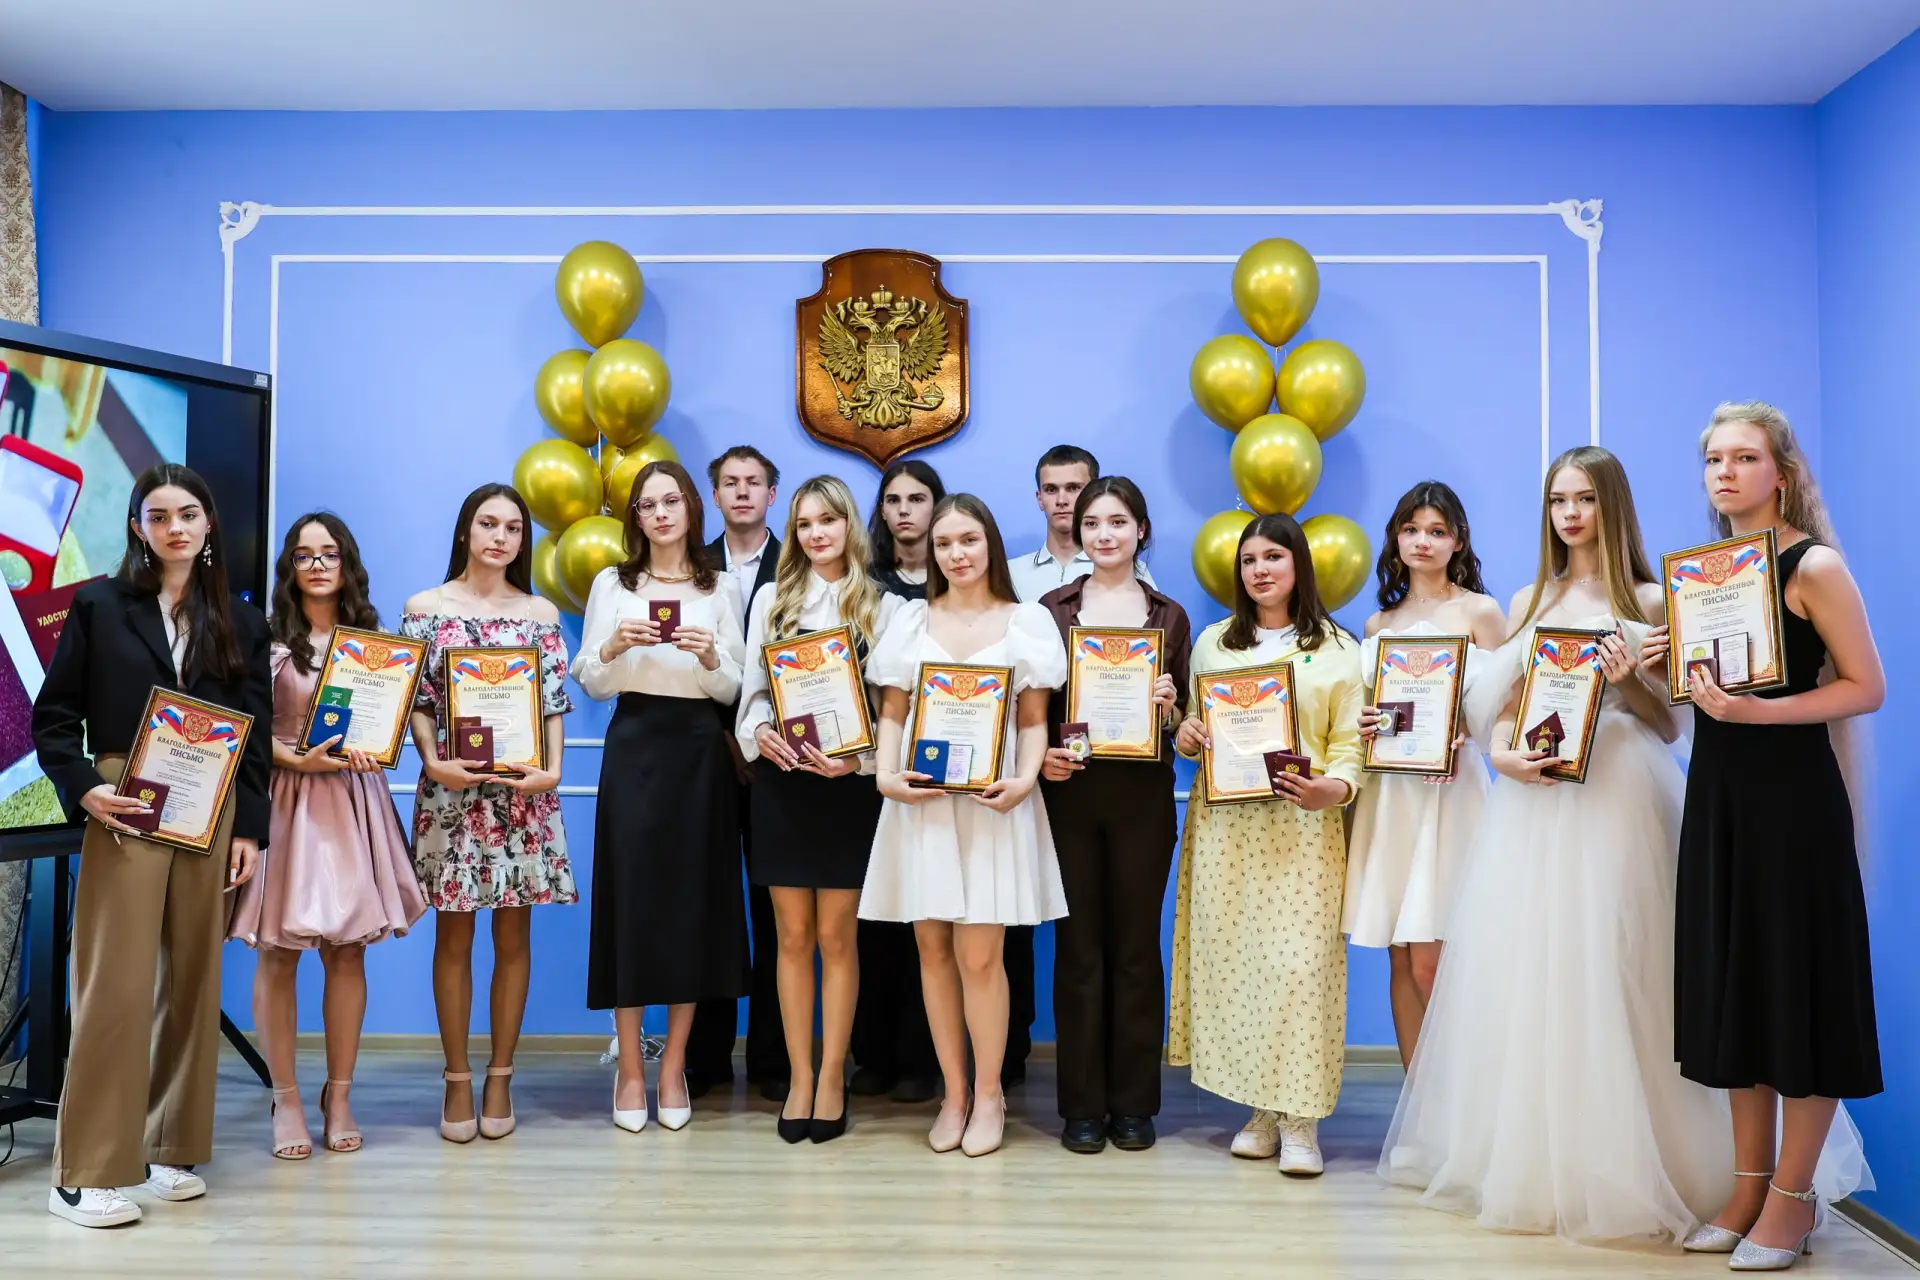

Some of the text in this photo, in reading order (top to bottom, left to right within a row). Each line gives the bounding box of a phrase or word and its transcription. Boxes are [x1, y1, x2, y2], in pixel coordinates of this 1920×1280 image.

[1684, 579, 1756, 600] БЛАГОДАРСТВЕННОЕ
[1701, 592, 1739, 607] ПИСЬМО
[36, 608, 70, 627] УДОСТО
[340, 667, 401, 683] БЛАГОДАРСТВЕННОЕ
[1099, 672, 1131, 680] ПИСЬМО
[1539, 671, 1589, 682] БЛАГОДАРСТВЕННОЕ
[352, 676, 385, 688] ПИСЬМО
[800, 676, 830, 689] ПИСЬМО
[1549, 679, 1576, 690] ПИСЬМО
[478, 692, 511, 700] ПИСЬМО
[1401, 686, 1431, 694] ПИСЬМО
[945, 707, 977, 716] ПИСЬМО
[1231, 715, 1264, 725] ПИСЬМО
[156, 736, 222, 760] БЛАГОДАРСТВЕННОЕ
[169, 748, 205, 764] ПИСЬМО
